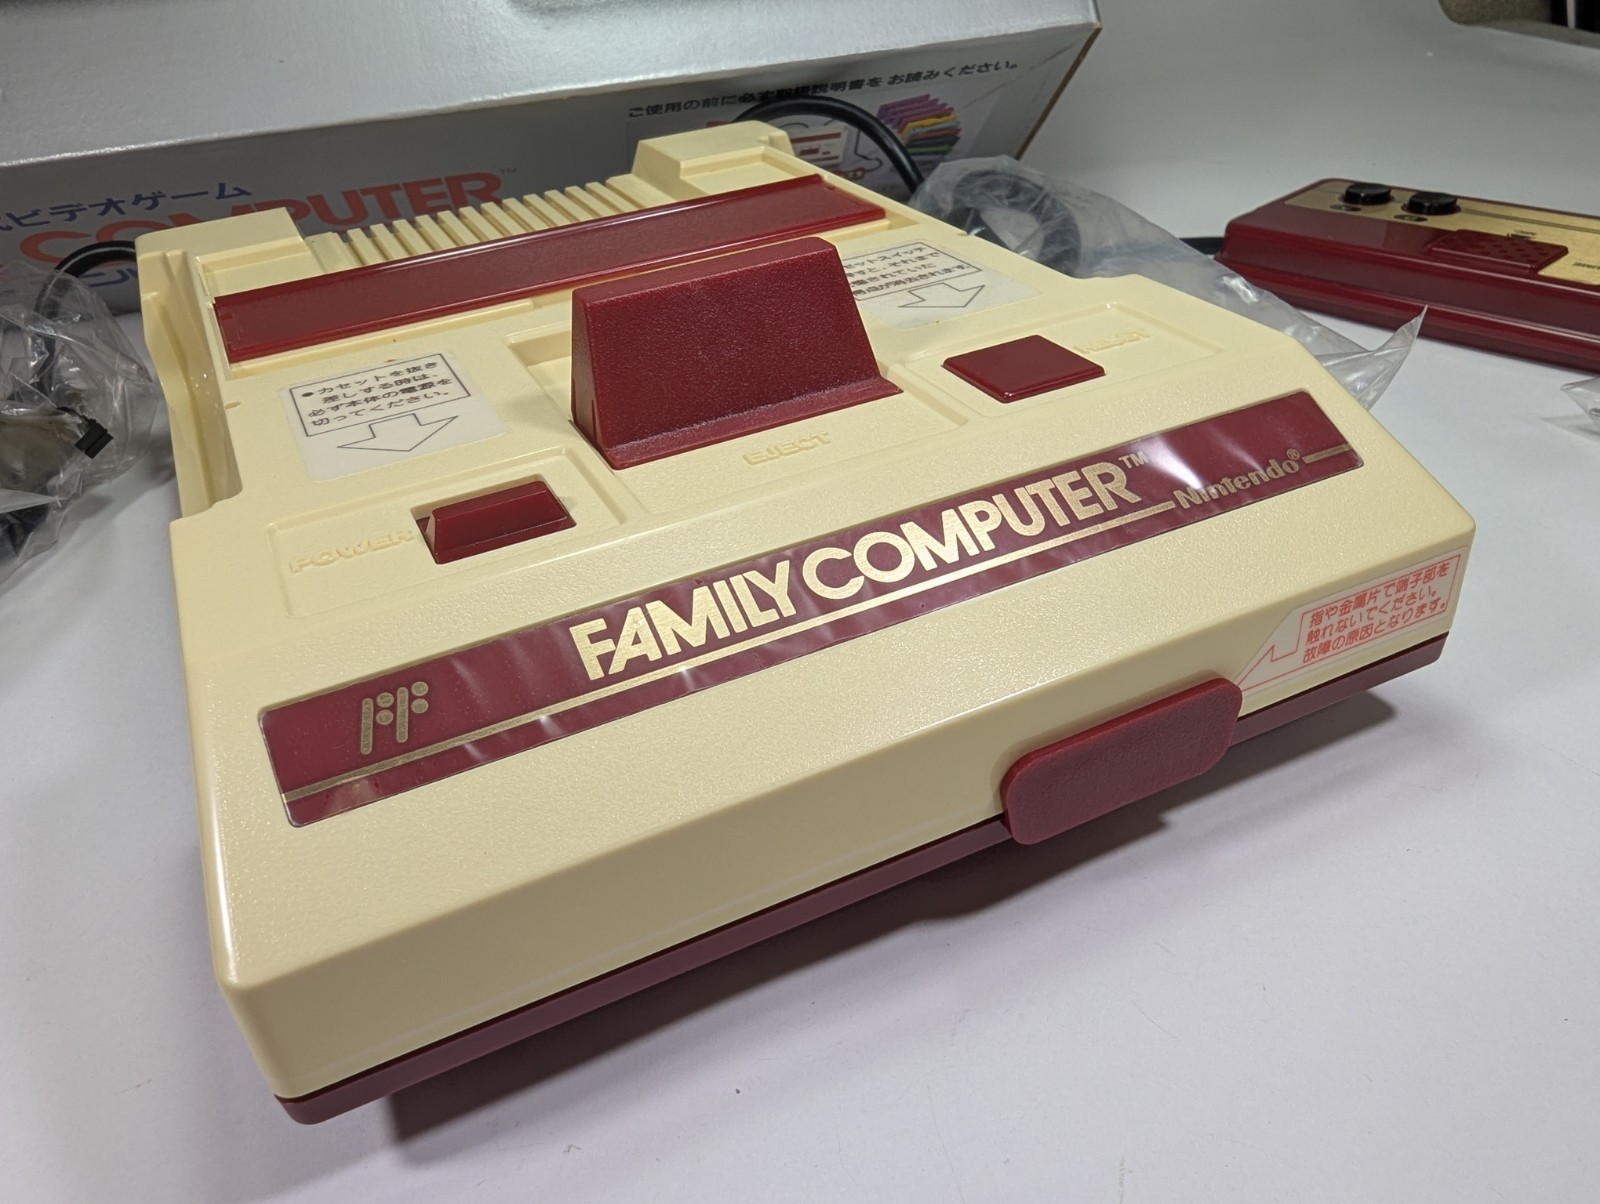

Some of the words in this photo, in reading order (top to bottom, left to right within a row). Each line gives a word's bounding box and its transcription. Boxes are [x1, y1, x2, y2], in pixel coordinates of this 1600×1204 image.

[742, 431, 831, 465] EJECT
[289, 530, 415, 574] POWER
[569, 560, 797, 680] FAMILY
[802, 462, 1140, 600] COMPUTER
[1305, 585, 1437, 646] 触れないでください。
[1309, 562, 1450, 628] 指や金属片で端子部を
[1302, 597, 1446, 664] 故障の原因となります。
